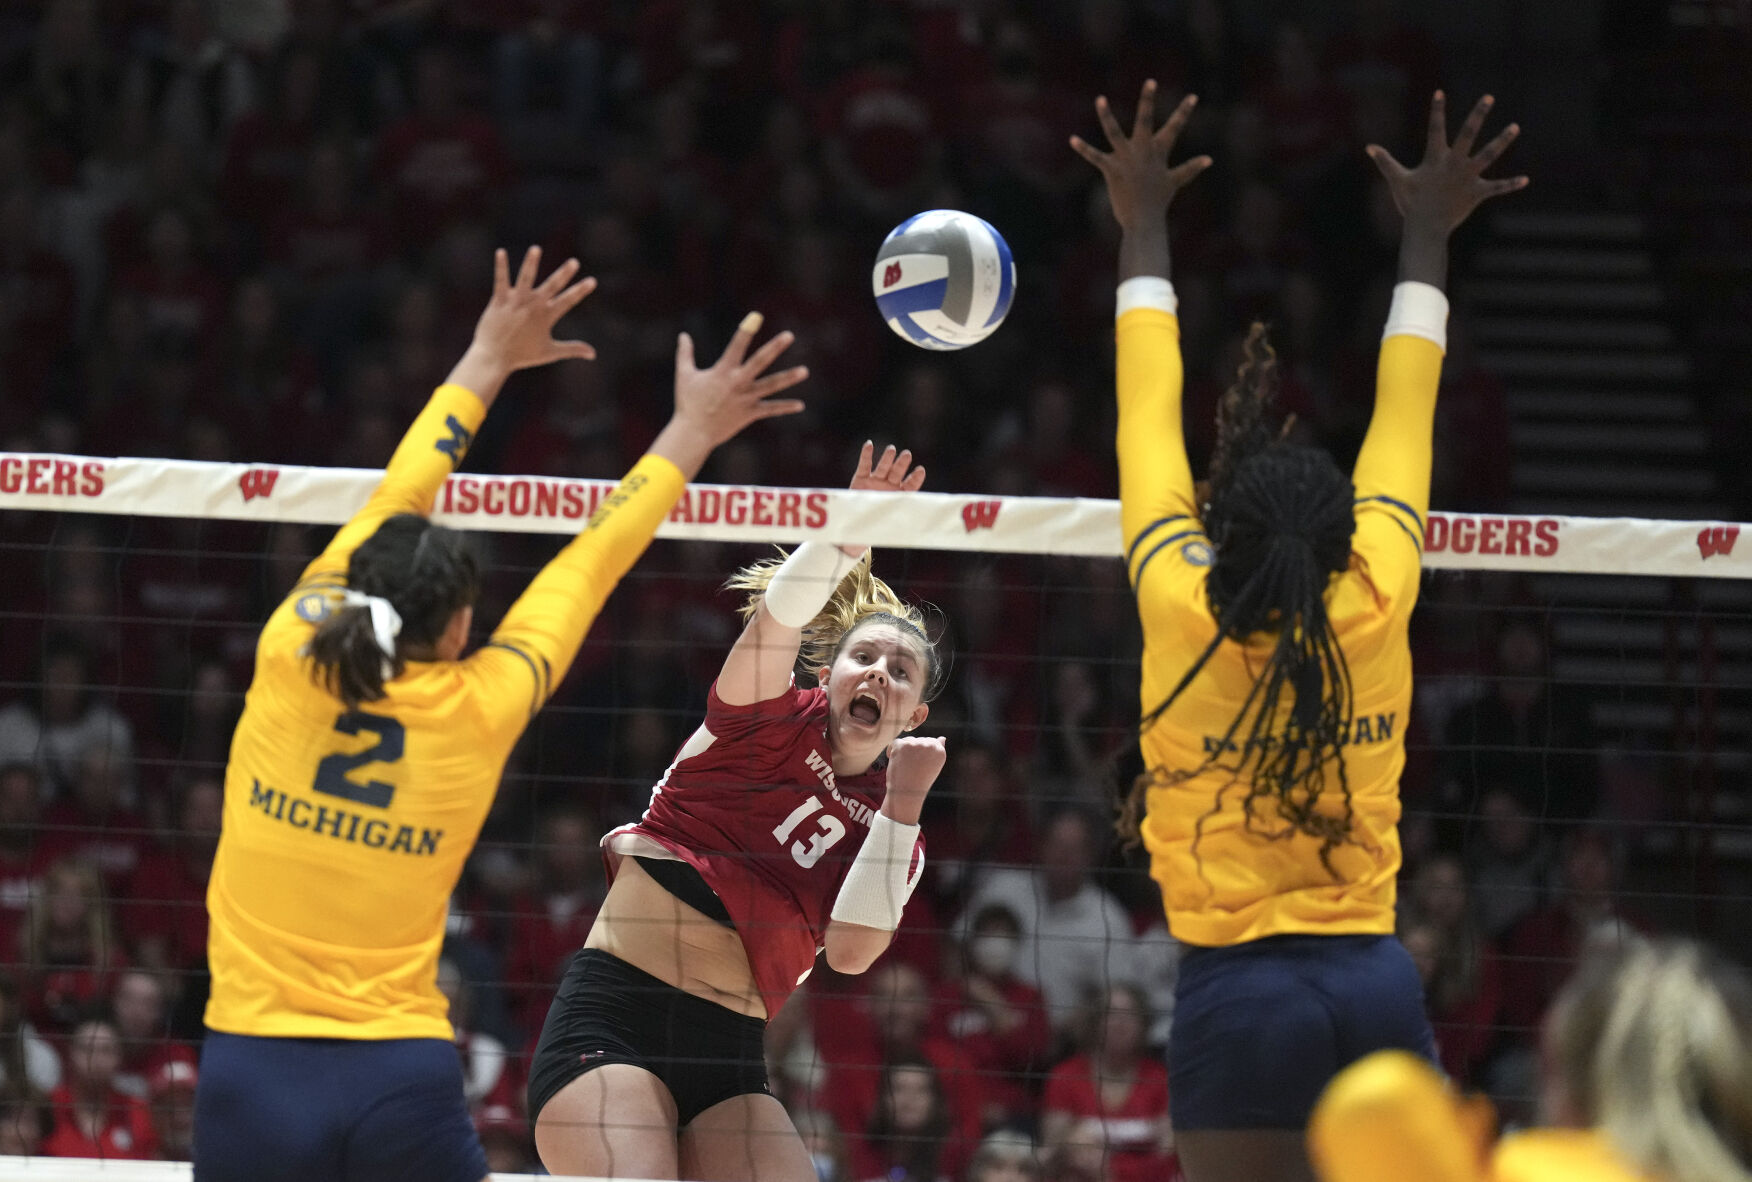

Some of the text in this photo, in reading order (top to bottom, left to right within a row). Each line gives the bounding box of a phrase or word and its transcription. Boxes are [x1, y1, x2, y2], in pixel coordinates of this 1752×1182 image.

[1, 458, 104, 497] GERS
[239, 469, 279, 503] W
[443, 479, 614, 519] ISCONSI
[962, 501, 1002, 533] W
[1697, 526, 1740, 560] W
[313, 711, 405, 809] 2
[805, 748, 875, 828] WISCSIN
[250, 777, 445, 856] MICHIGAN
[772, 795, 846, 869] 13
